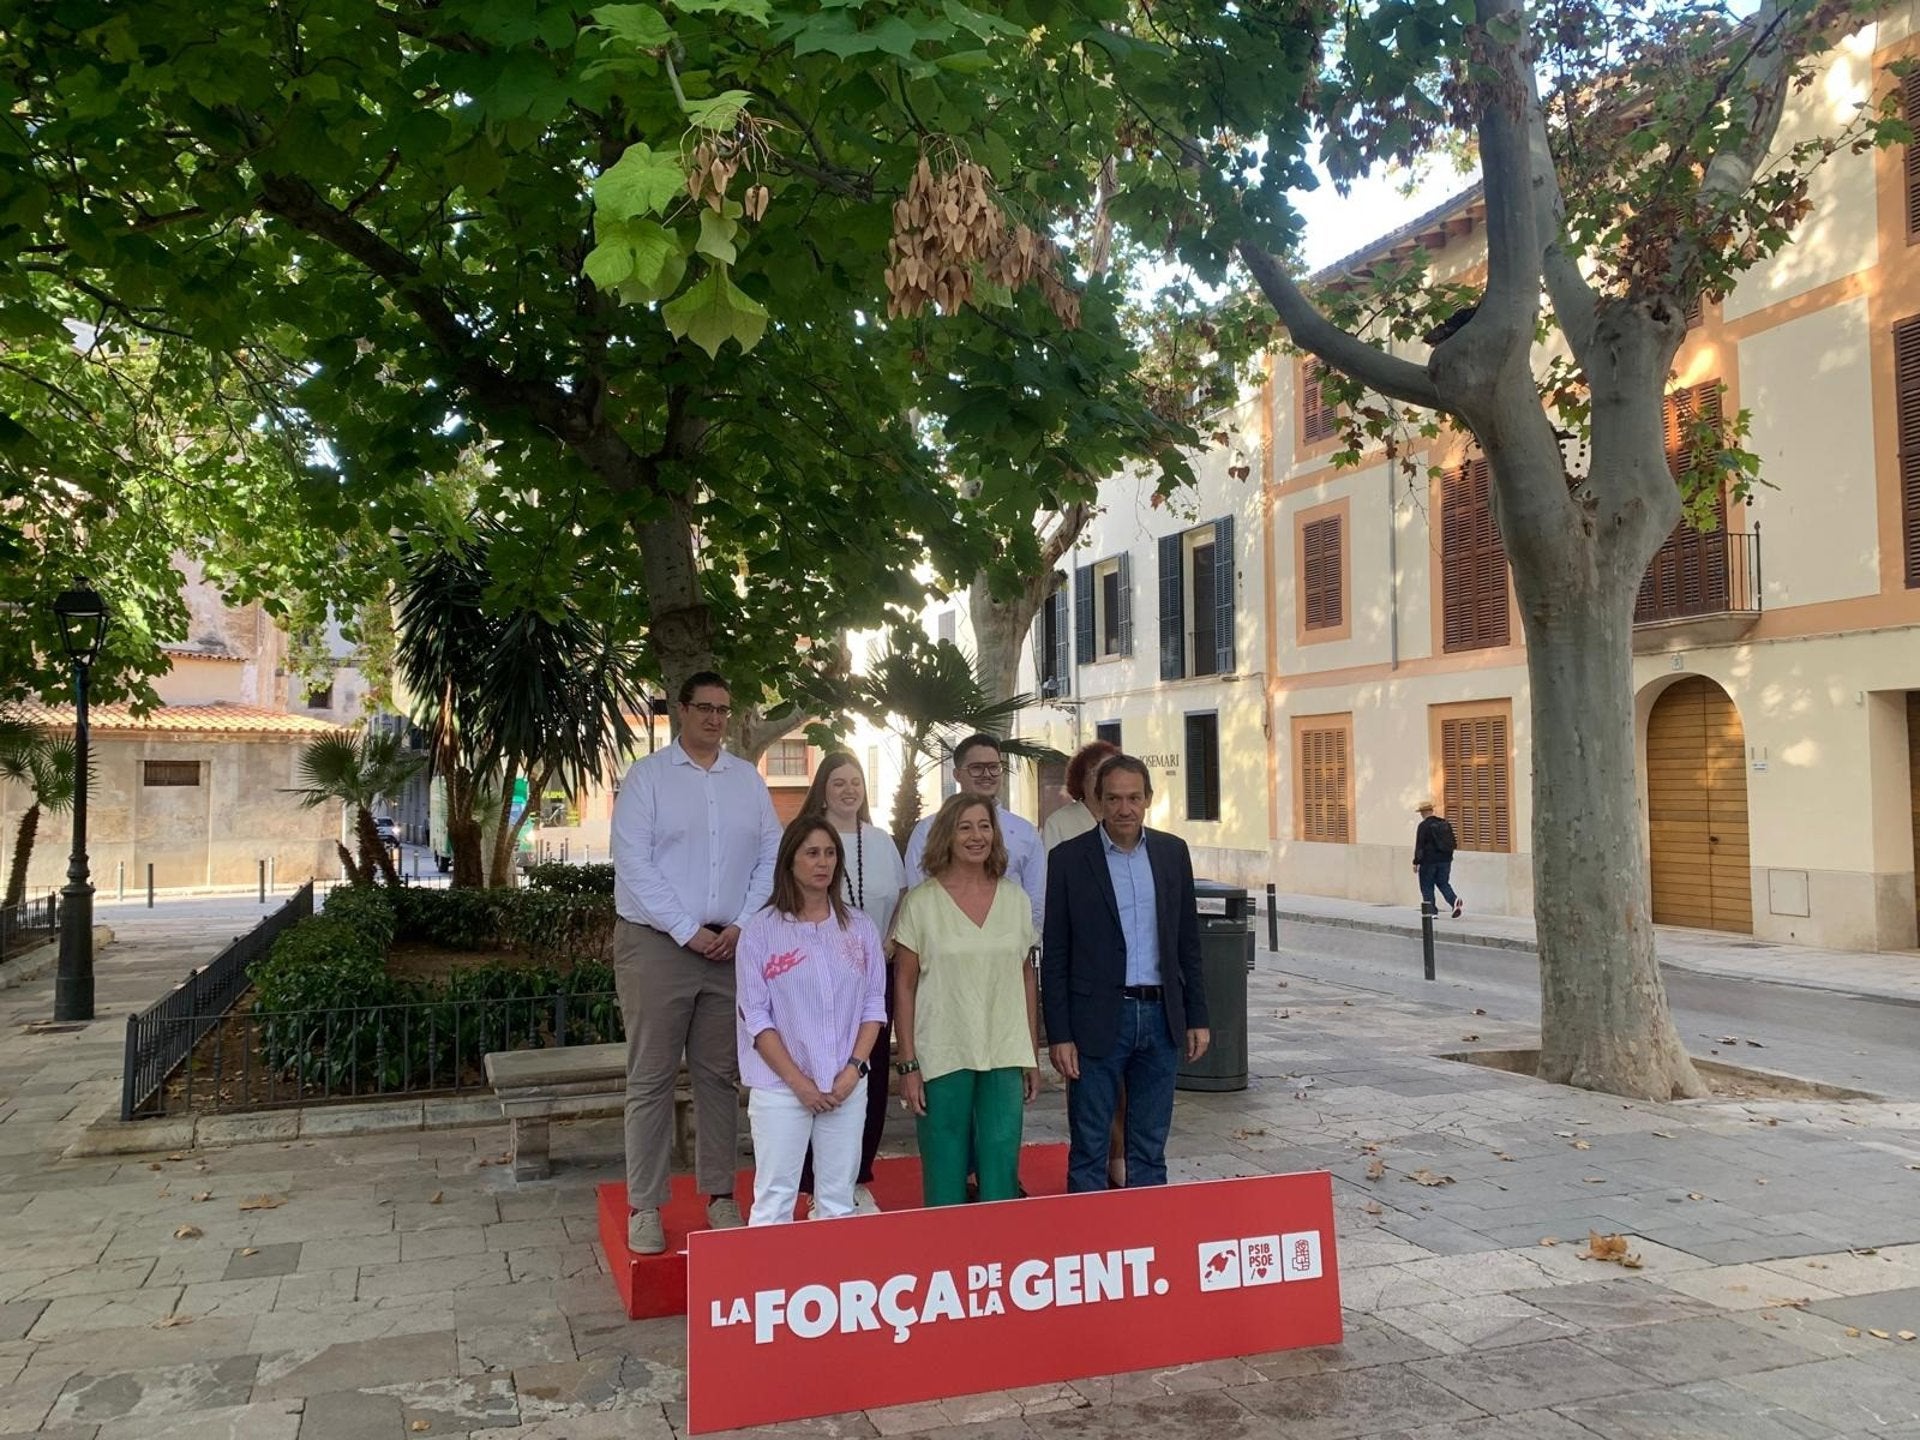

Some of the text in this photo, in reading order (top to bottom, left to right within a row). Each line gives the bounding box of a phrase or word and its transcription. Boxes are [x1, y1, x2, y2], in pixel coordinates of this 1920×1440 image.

[1139, 754, 1179, 768] OSEMARI
[1248, 1243, 1270, 1255] PSIB
[1249, 1254, 1274, 1267] PSOE
[711, 1247, 1170, 1345] LA FORÇA DE LA GENT.
